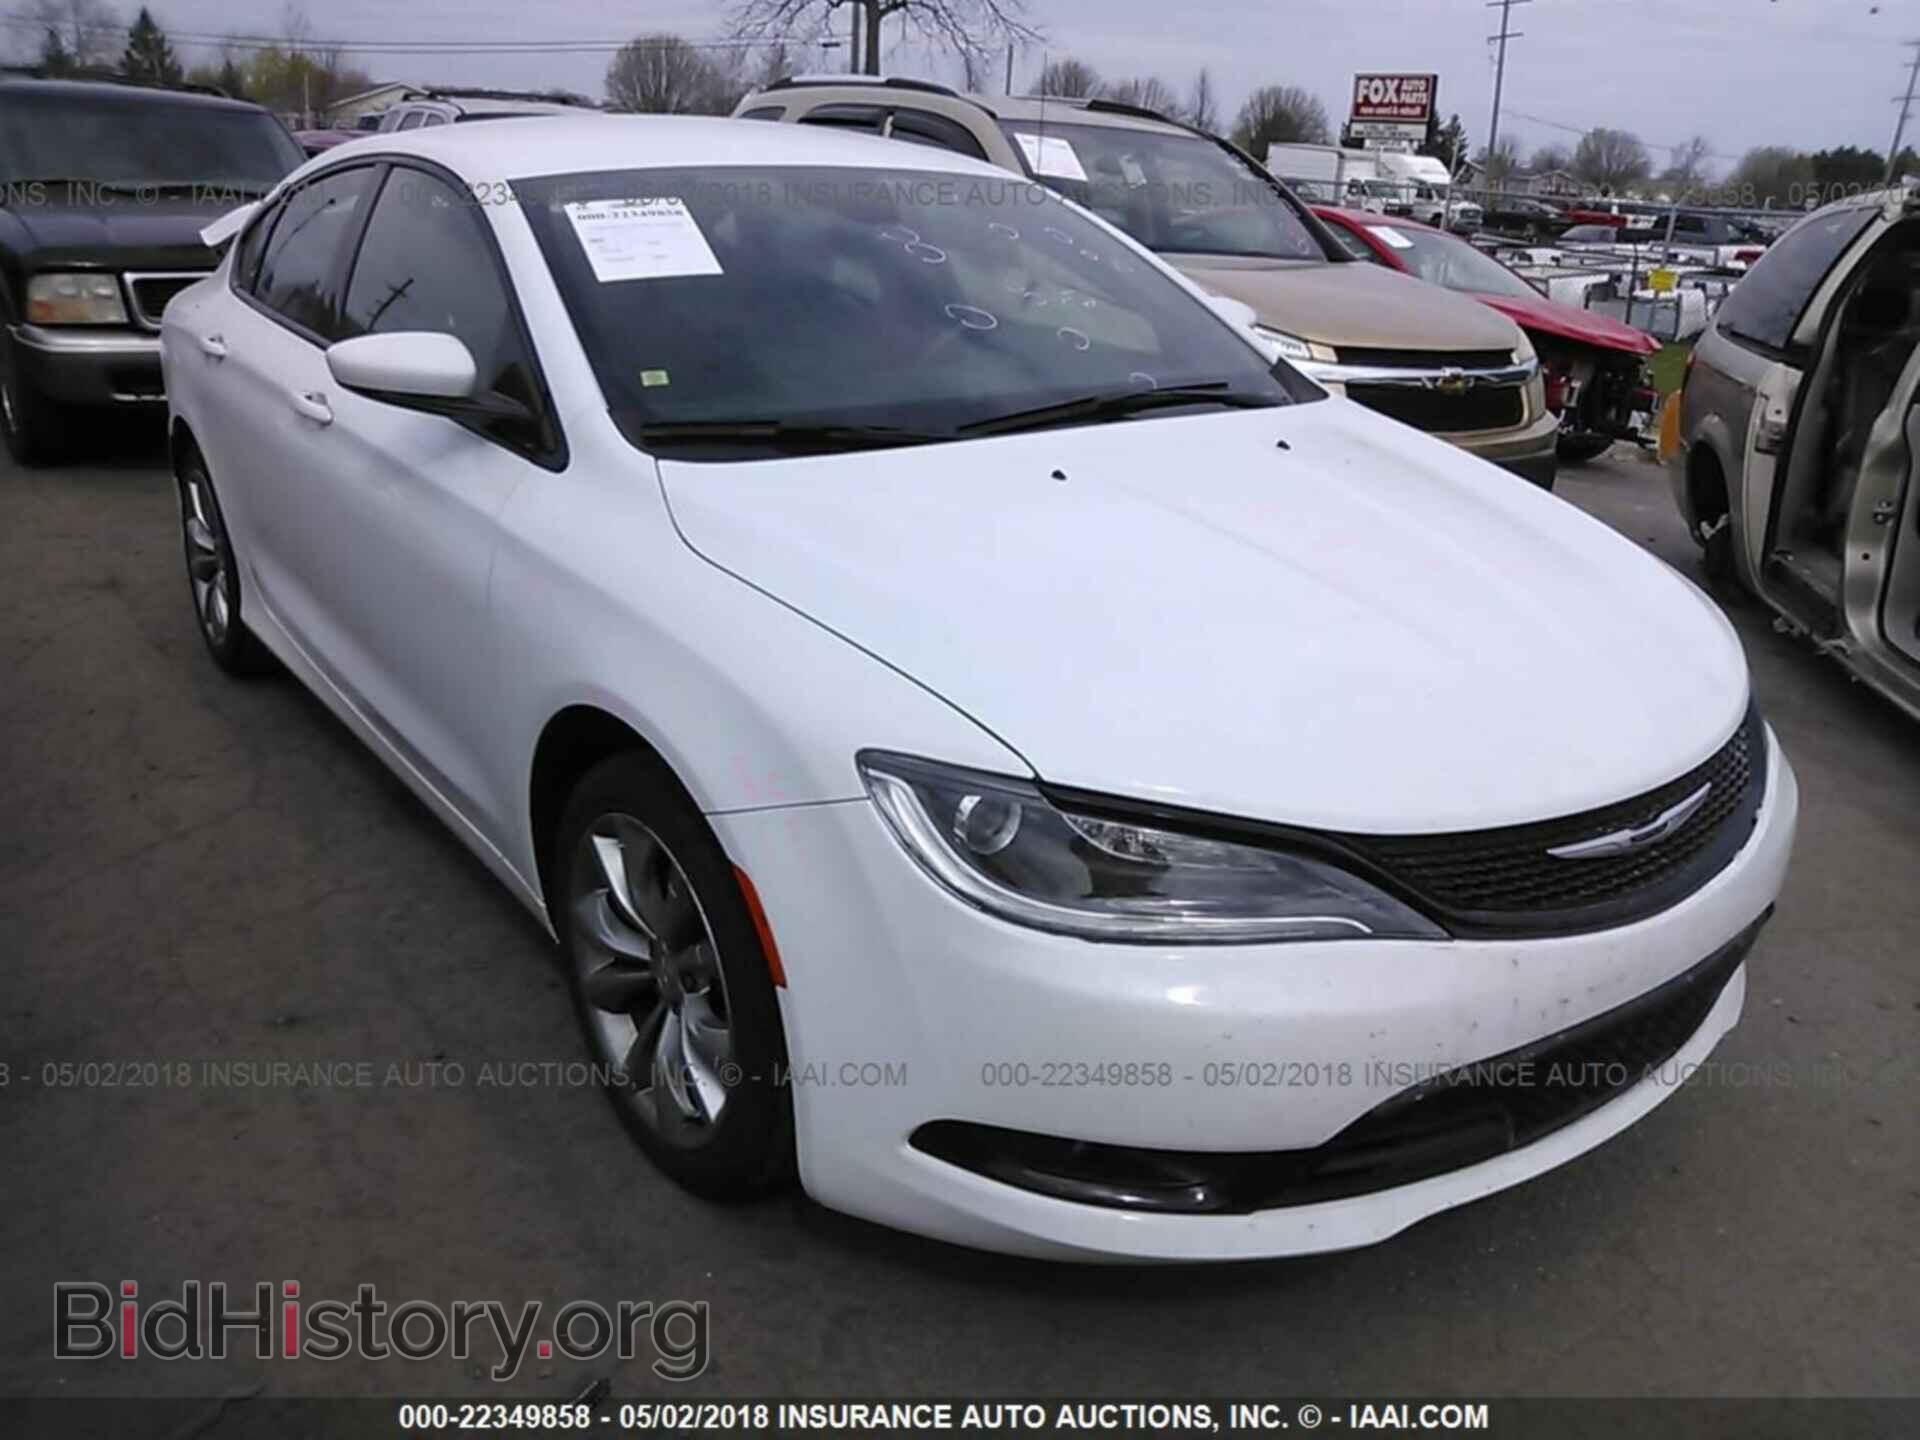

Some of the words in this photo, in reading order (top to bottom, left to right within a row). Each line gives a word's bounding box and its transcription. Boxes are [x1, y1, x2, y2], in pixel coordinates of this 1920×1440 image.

[1357, 78, 1400, 104] FOX
[1401, 79, 1427, 92] AUTO
[1400, 92, 1427, 104] PARTS
